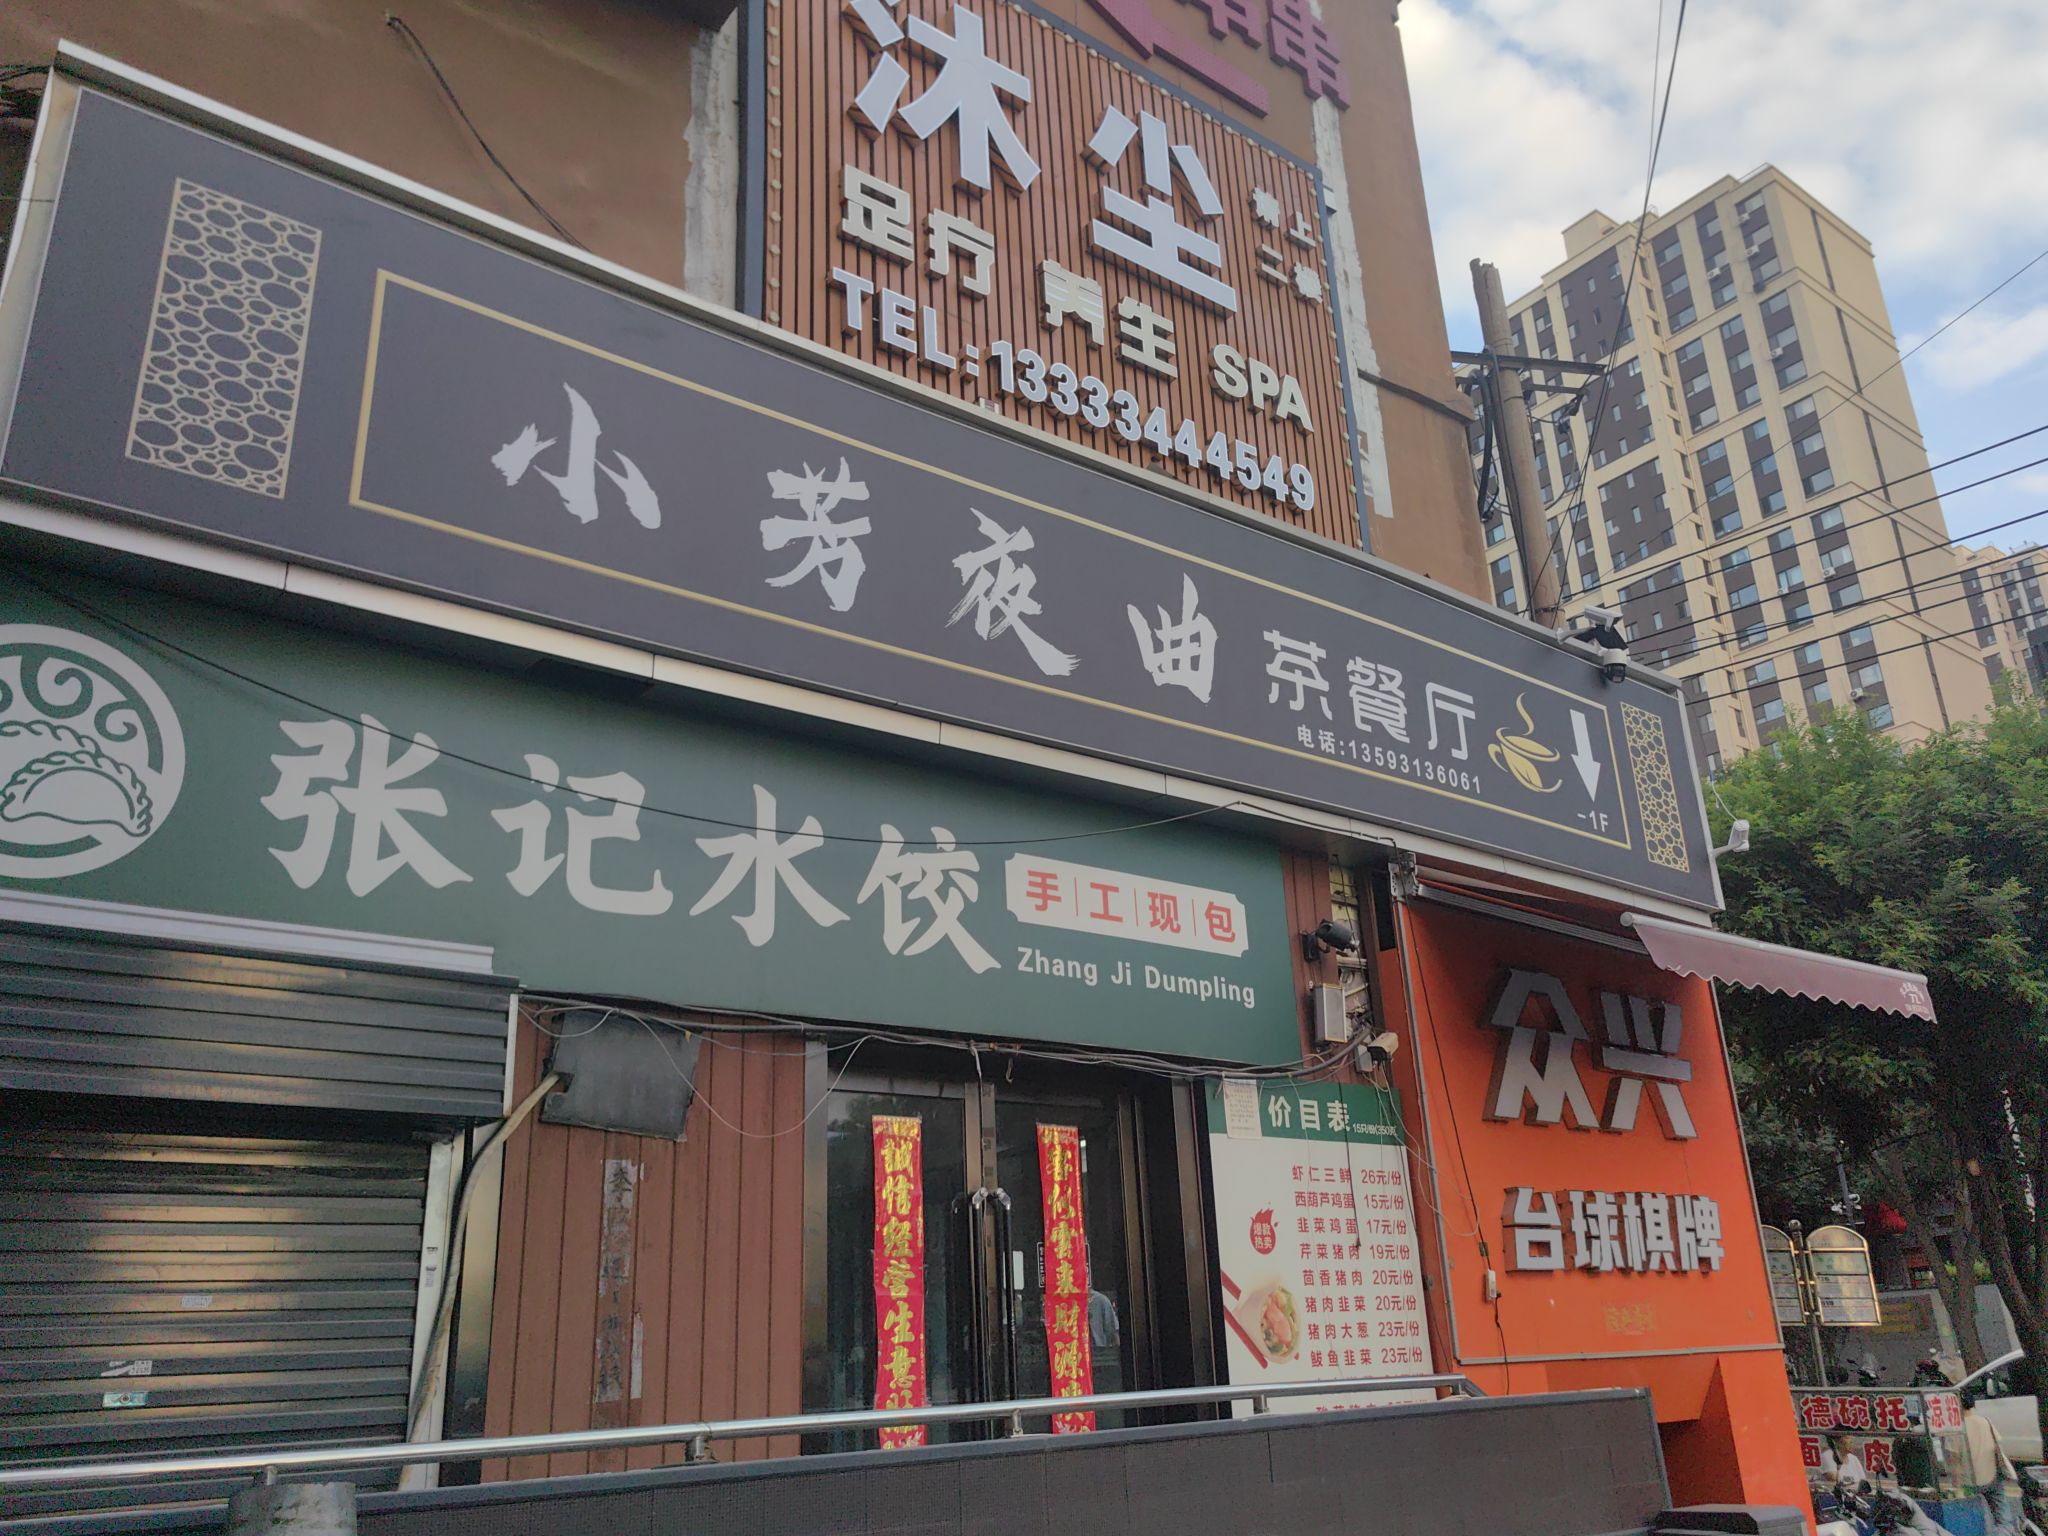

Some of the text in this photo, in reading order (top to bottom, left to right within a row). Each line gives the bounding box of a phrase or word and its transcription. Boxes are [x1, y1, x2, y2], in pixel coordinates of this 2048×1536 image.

[851, 0, 1237, 312] 沐尘
[841, 164, 995, 296] 足疗
[1213, 343, 1314, 434] SPA
[491, 382, 1476, 760] 小芳夜曲 茶餐厅
[260, 713, 1001, 974] 张记水饺
[1026, 870, 1236, 943] 手工现包
[1017, 946, 1255, 1008] Zhang Ji Dumpling
[1486, 967, 1698, 1140] 众兴
[1267, 1095, 1350, 1131] 价目表
[1291, 1165, 1402, 1185] 虾仁三鲜 26元/份
[1295, 1191, 1404, 1210] 西葫芦鸡蛋 15元/份
[1297, 1217, 1407, 1235] 韭菜鸡蛋 17元/份
[1506, 1187, 1725, 1272] 台球棋牌
[1300, 1243, 1410, 1260] 芹菜猪肉 19元/份
[1302, 1269, 1413, 1286] 茴香猪肉 20元/份
[1305, 1296, 1416, 1313] 猪肉韭菜 20元/份
[1308, 1321, 1419, 1340] 猪肉大葱 23元/份
[1310, 1348, 1423, 1368] 鲅鱼韭菜 23元/份
